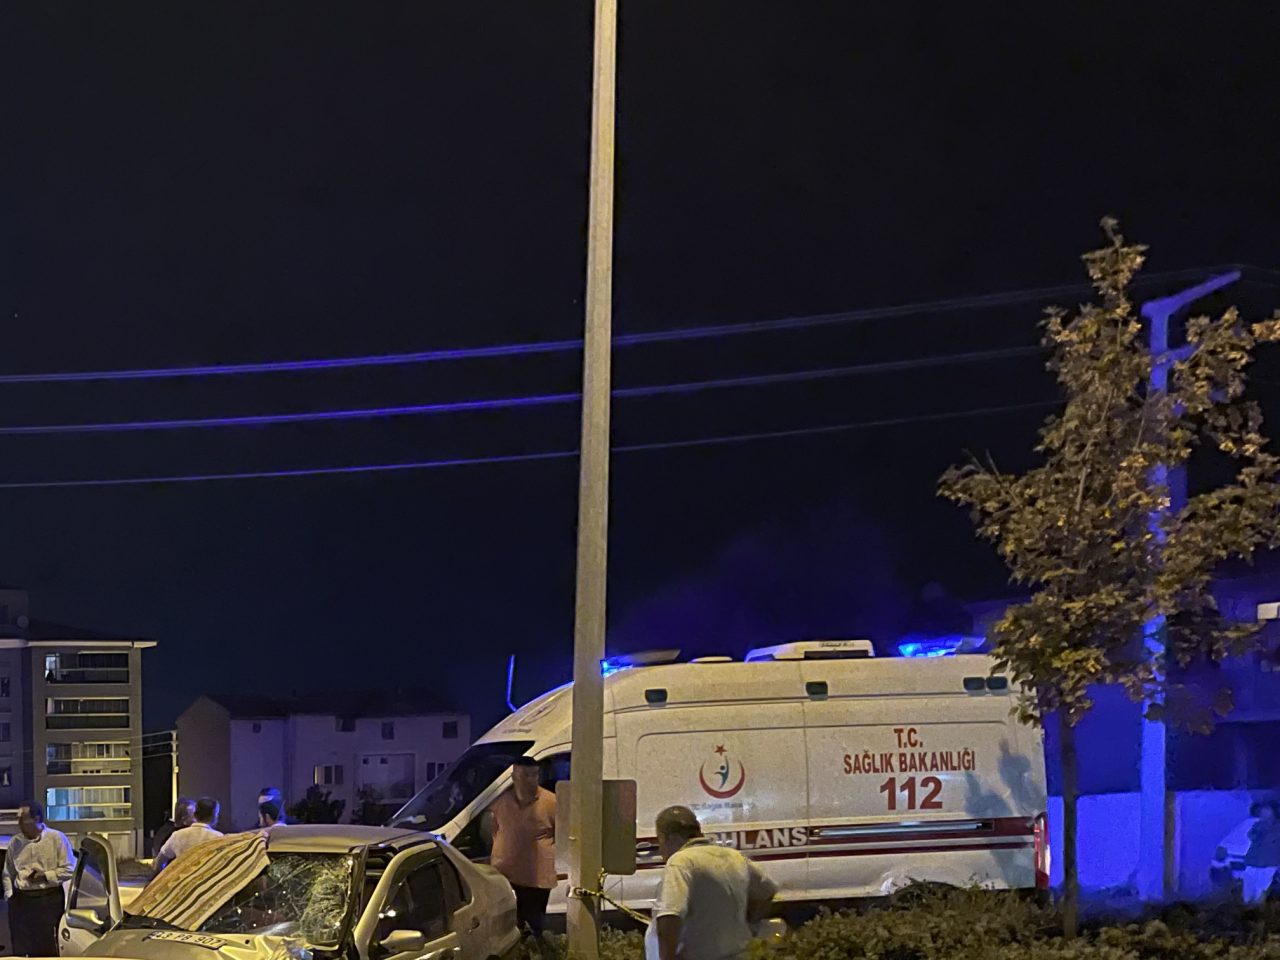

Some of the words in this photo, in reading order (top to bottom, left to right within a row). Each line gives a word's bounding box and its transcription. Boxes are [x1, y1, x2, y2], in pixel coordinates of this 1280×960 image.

[893, 727, 923, 748] T.C.
[843, 750, 894, 774] SAĞLIK
[899, 747, 976, 773] BAKANLIĞI
[879, 776, 943, 810] 112
